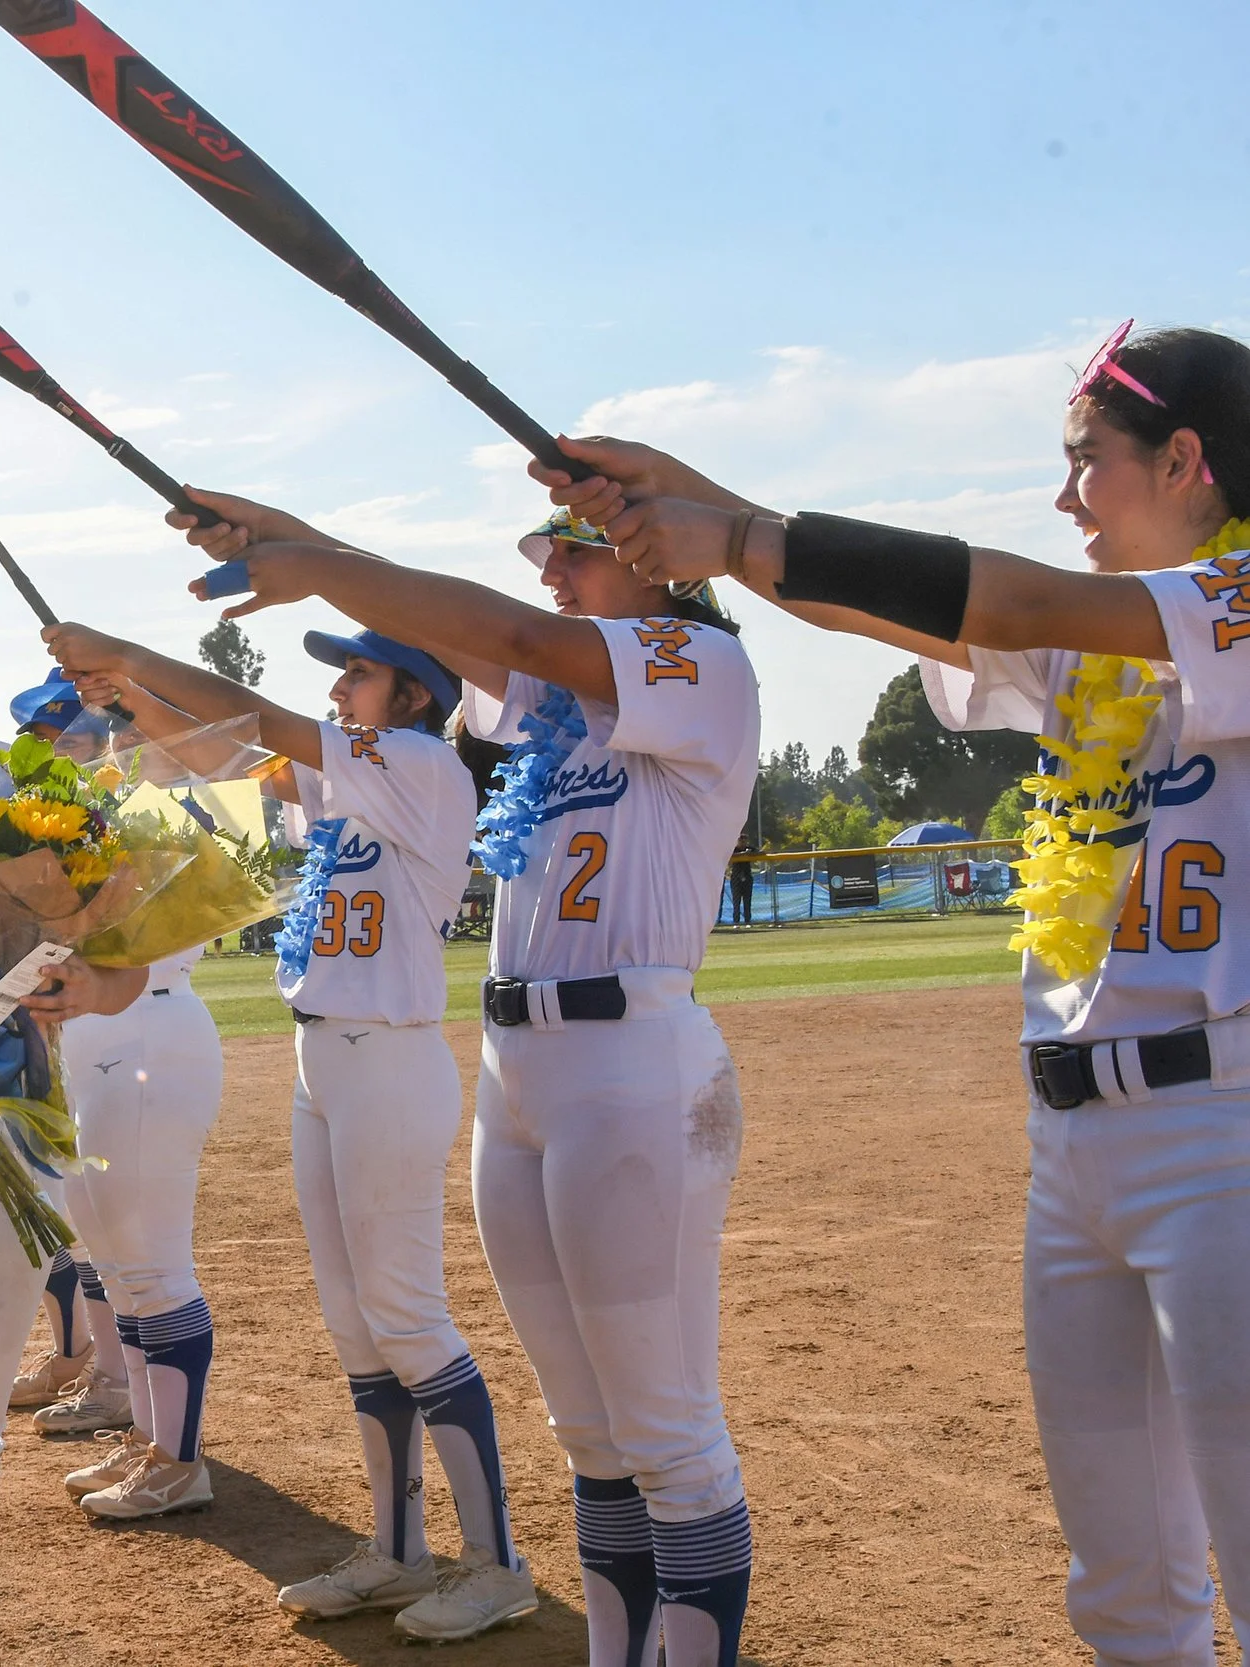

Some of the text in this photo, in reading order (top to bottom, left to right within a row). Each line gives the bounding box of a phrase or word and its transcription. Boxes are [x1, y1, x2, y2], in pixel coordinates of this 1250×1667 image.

[134, 86, 243, 161] RXT
[558, 832, 608, 923] 2
[312, 890, 385, 957] 33
